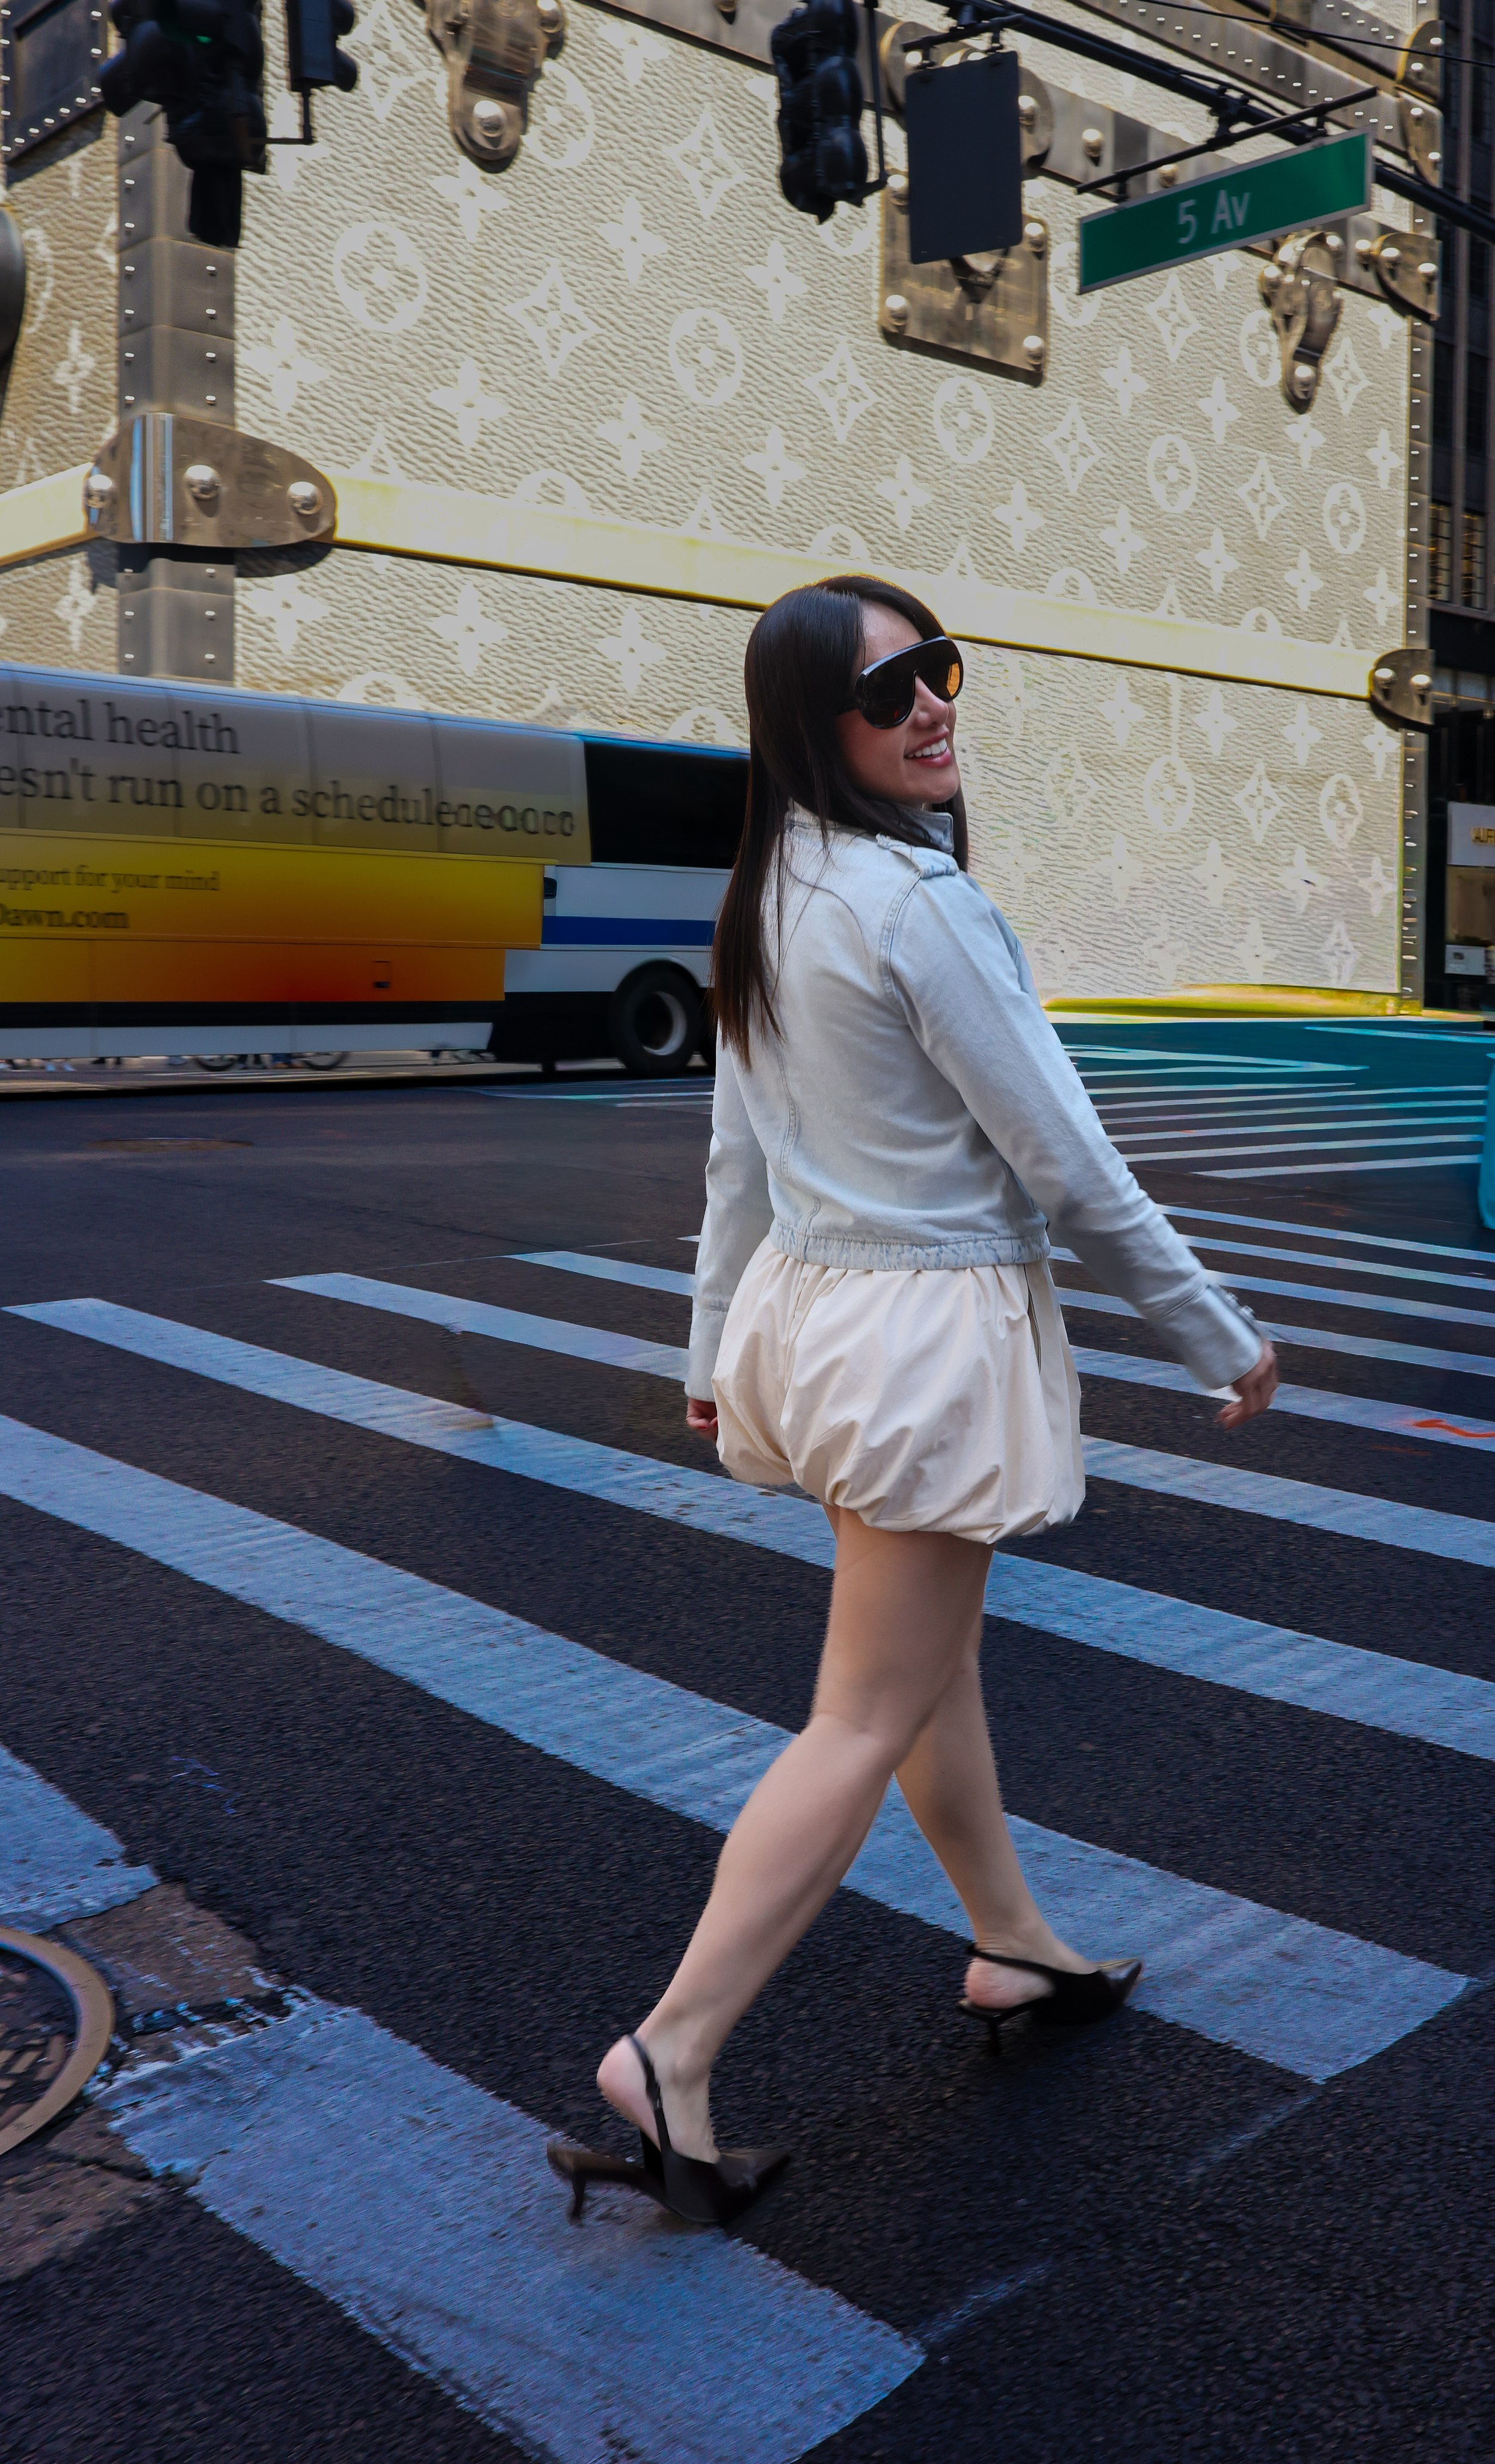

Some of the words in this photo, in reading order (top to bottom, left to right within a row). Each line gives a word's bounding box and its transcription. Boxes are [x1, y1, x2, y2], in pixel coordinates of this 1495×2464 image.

[1178, 199, 1198, 244] 5
[1210, 189, 1251, 234] Av
[0, 699, 94, 741] ntal
[103, 701, 241, 754] health
[0, 757, 96, 802] esn't
[106, 775, 186, 808] run
[196, 782, 249, 812] on
[259, 787, 283, 815] a
[76, 864, 106, 887] for
[111, 872, 159, 894] your
[164, 870, 220, 891] mind
